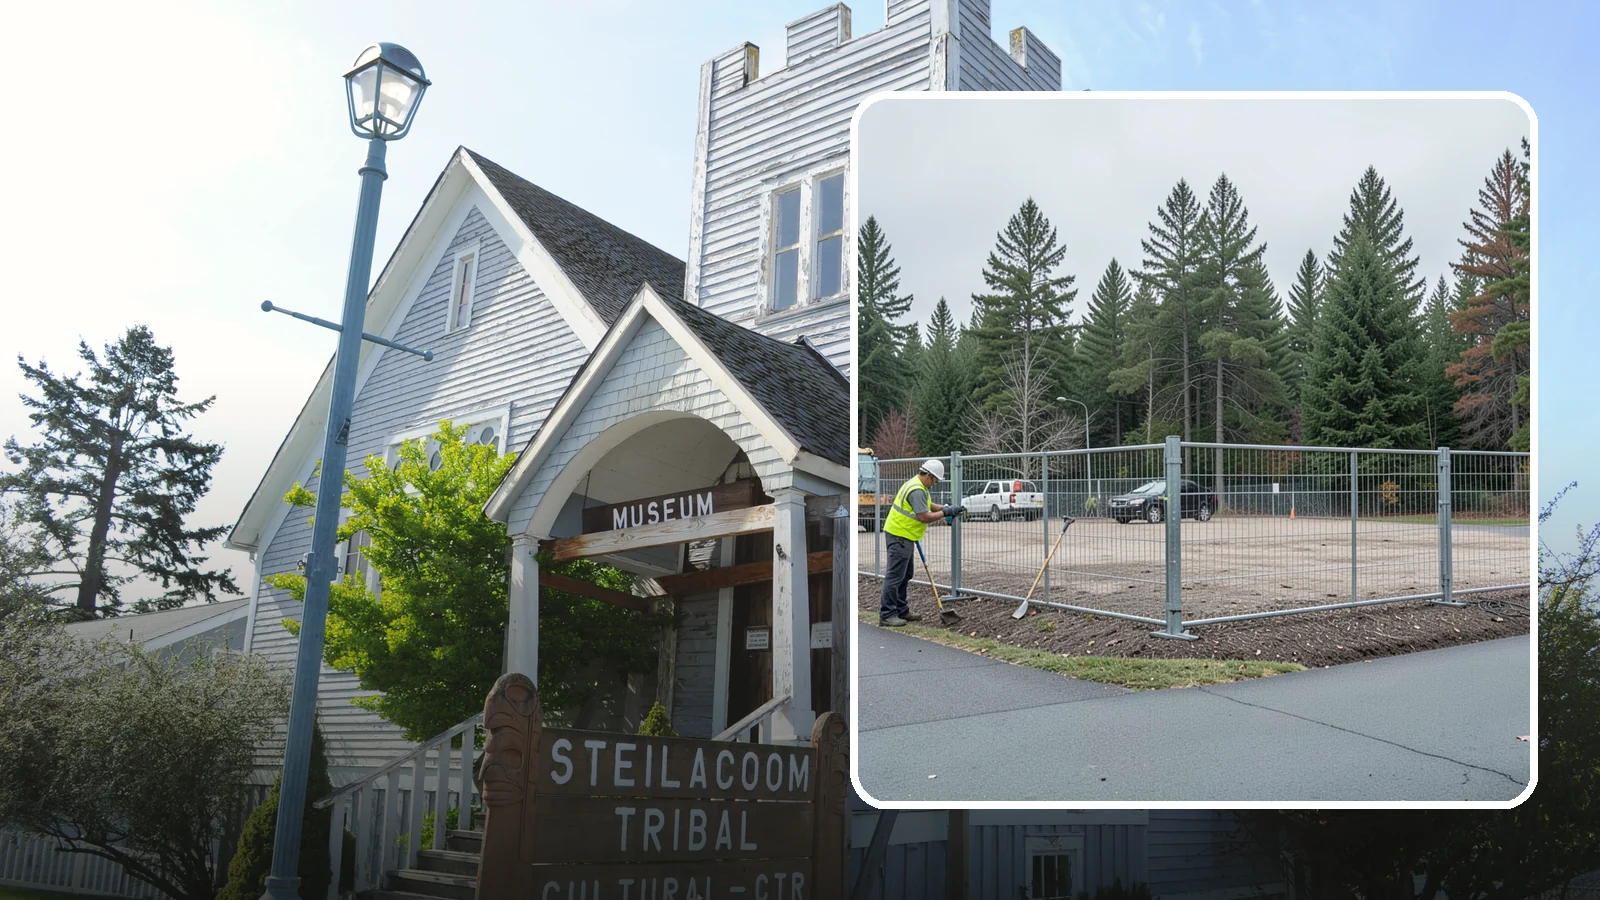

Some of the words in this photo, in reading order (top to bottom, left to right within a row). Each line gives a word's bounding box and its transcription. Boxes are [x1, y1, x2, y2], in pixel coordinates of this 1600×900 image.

[613, 491, 713, 530] MUSEUM
[551, 738, 809, 792] STEILACOOM
[615, 807, 757, 852] TRIBAL
